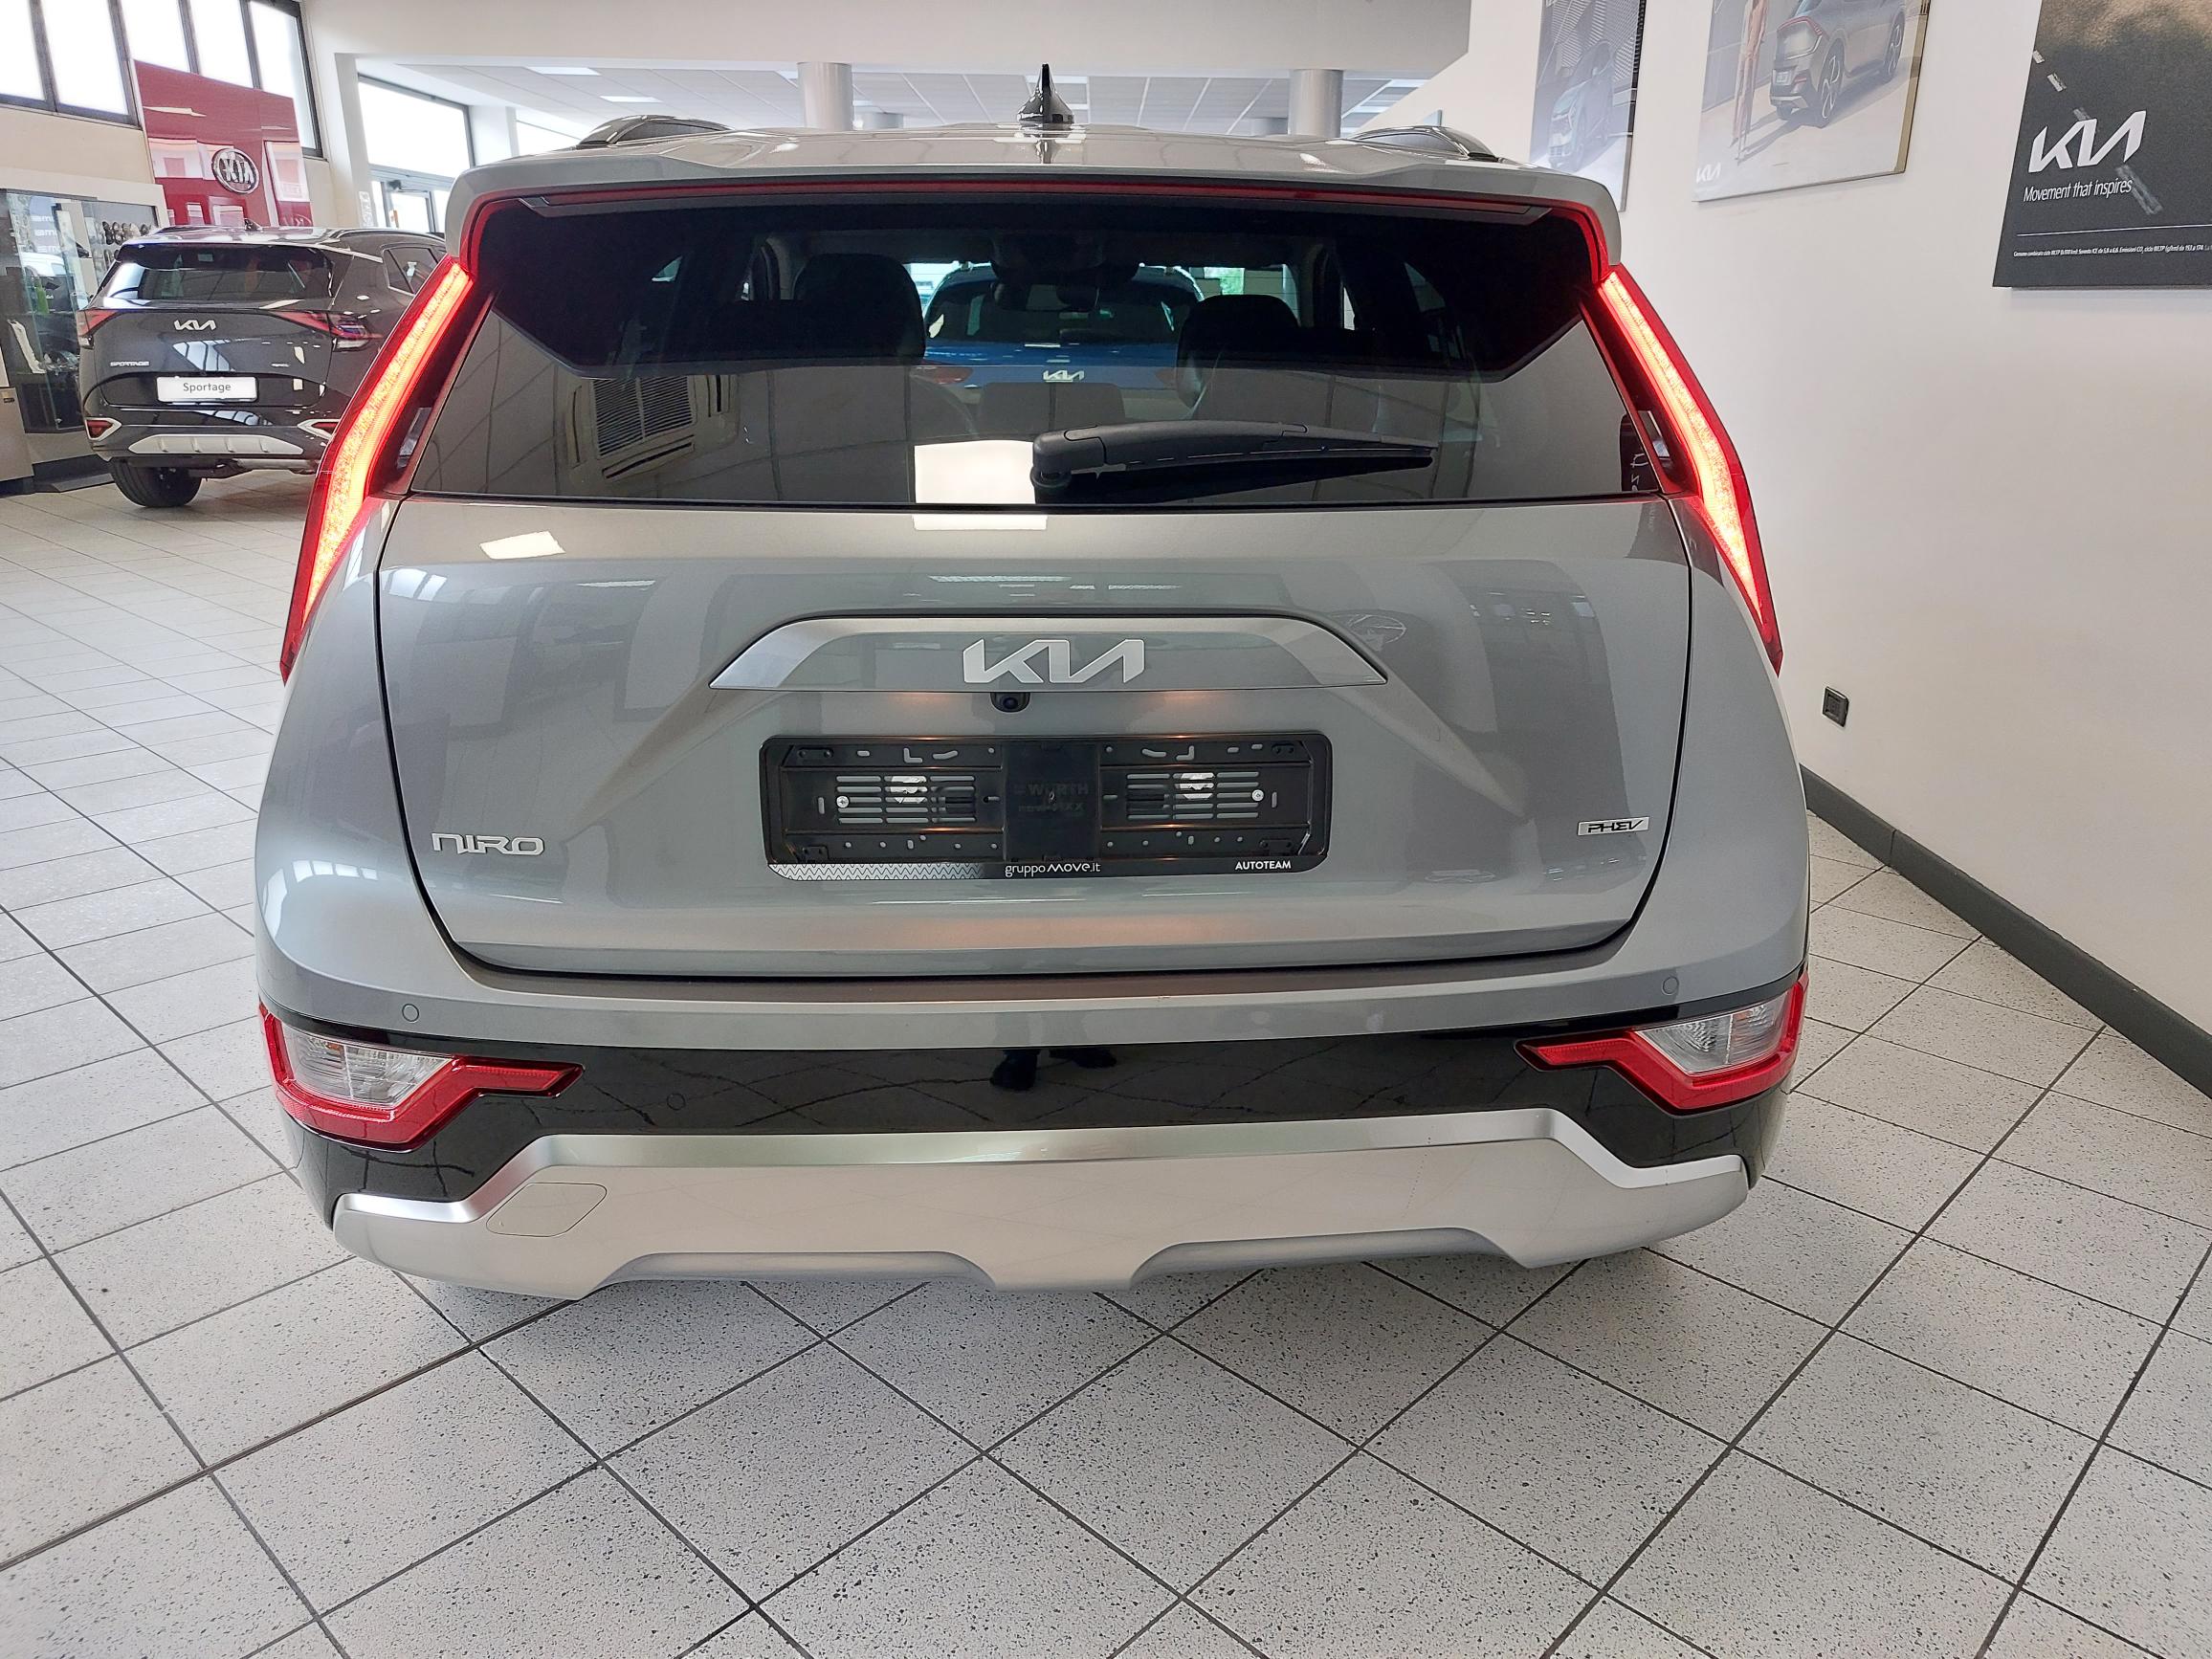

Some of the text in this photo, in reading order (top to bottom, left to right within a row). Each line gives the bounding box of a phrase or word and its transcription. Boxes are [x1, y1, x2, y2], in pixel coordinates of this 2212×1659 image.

[2028, 110, 2147, 173] KIA
[2024, 178, 2134, 202] Movement that inspires
[174, 320, 216, 331] KIA
[183, 383, 232, 393] Sportage
[962, 638, 1145, 683] KIA
[1587, 820, 1644, 833] PHEV
[431, 832, 544, 855] NIRO
[1235, 860, 1292, 871] AUTOTEAM
